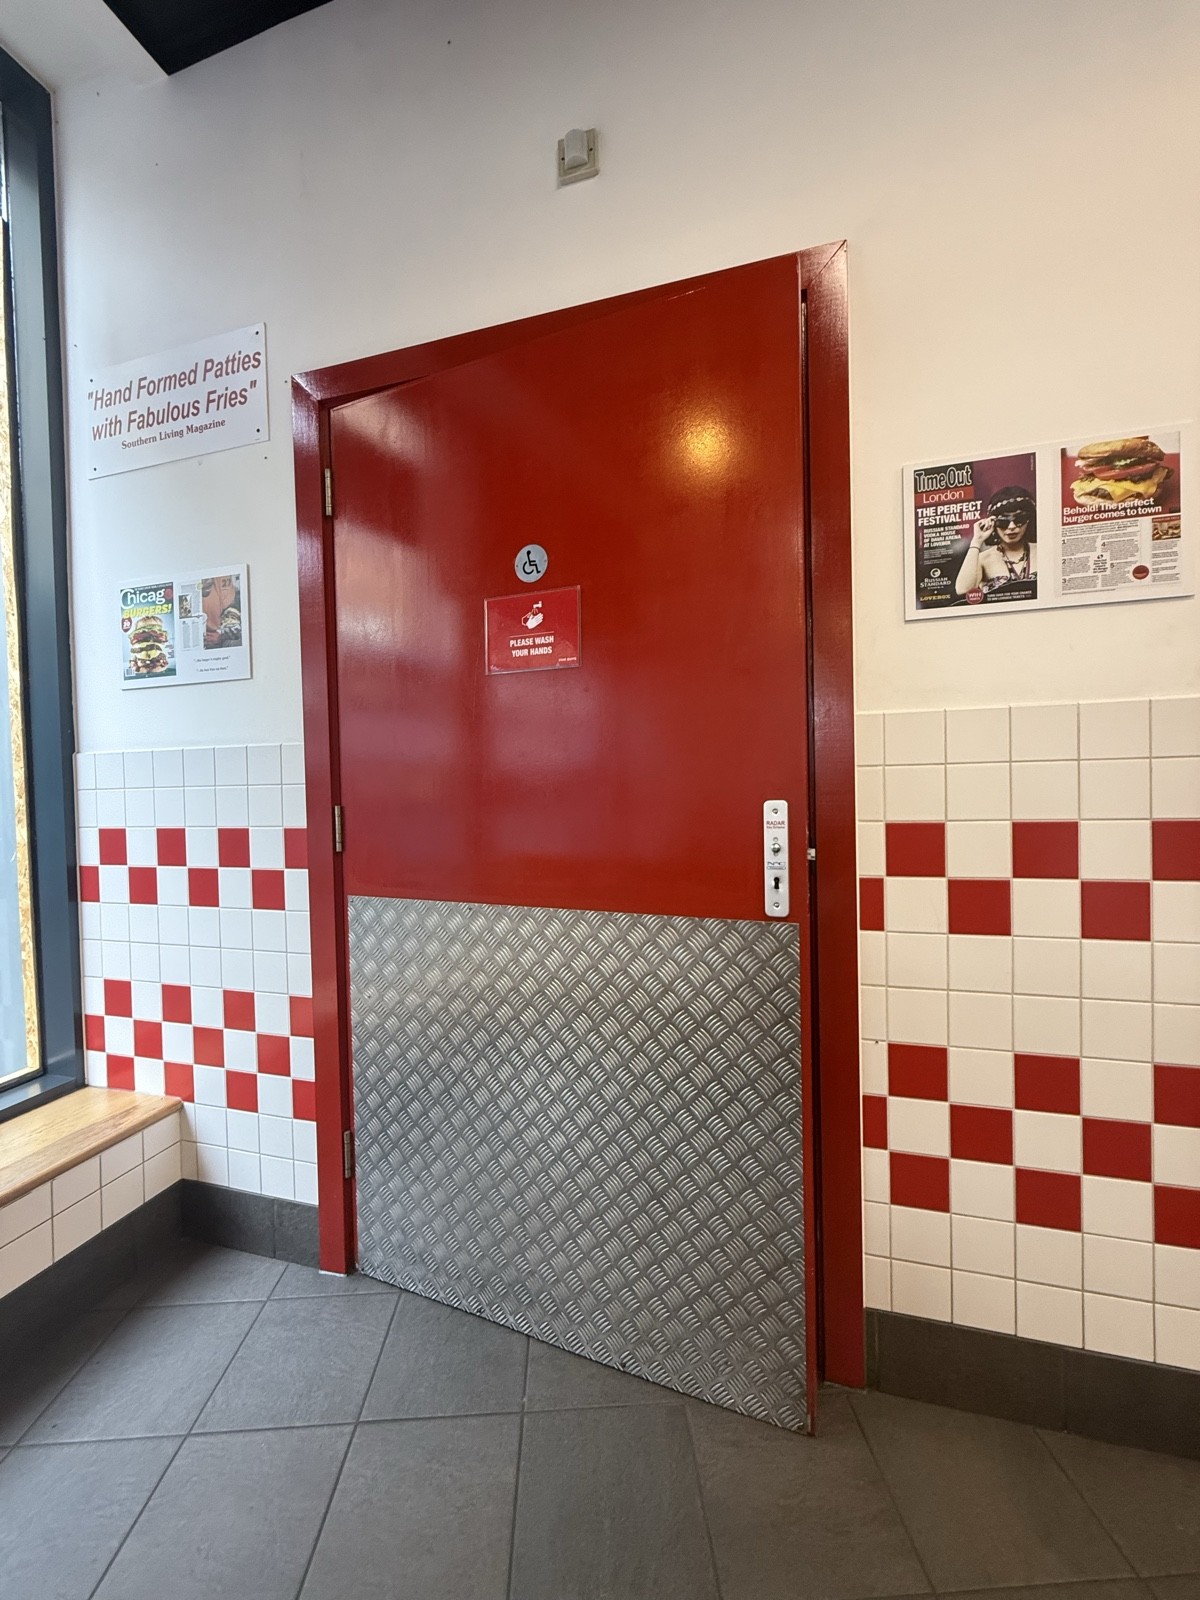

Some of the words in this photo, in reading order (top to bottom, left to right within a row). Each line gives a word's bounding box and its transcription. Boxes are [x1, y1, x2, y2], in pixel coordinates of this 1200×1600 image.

[88, 380, 132, 410] "Hand
[136, 363, 198, 399] Formed
[202, 351, 262, 382] Patties
[92, 414, 122, 441] with
[127, 399, 200, 432] Fabulous
[205, 379, 257, 413] Fries"
[121, 436, 157, 449] Southern
[159, 427, 184, 441] Living
[186, 418, 226, 434] Magazine
[915, 471, 946, 492] Time
[947, 465, 972, 487] Out
[923, 490, 964, 503] London
[917, 507, 936, 517] THE
[937, 501, 982, 515] PERFECT
[1063, 503, 1098, 515] Behold!
[1101, 502, 1118, 511] The
[1118, 498, 1155, 511] perfect
[1063, 514, 1093, 523] burger
[1094, 510, 1126, 520] comes
[1126, 507, 1137, 516] to
[1138, 506, 1162, 515] town
[918, 514, 961, 526] FESTIVAL
[962, 511, 981, 521] MIX
[123, 603, 172, 619] BURGERS!
[510, 637, 533, 647] PLEASE
[535, 635, 554, 645] WASH
[512, 648, 529, 657] YOUR
[530, 646, 552, 656] HANDS
